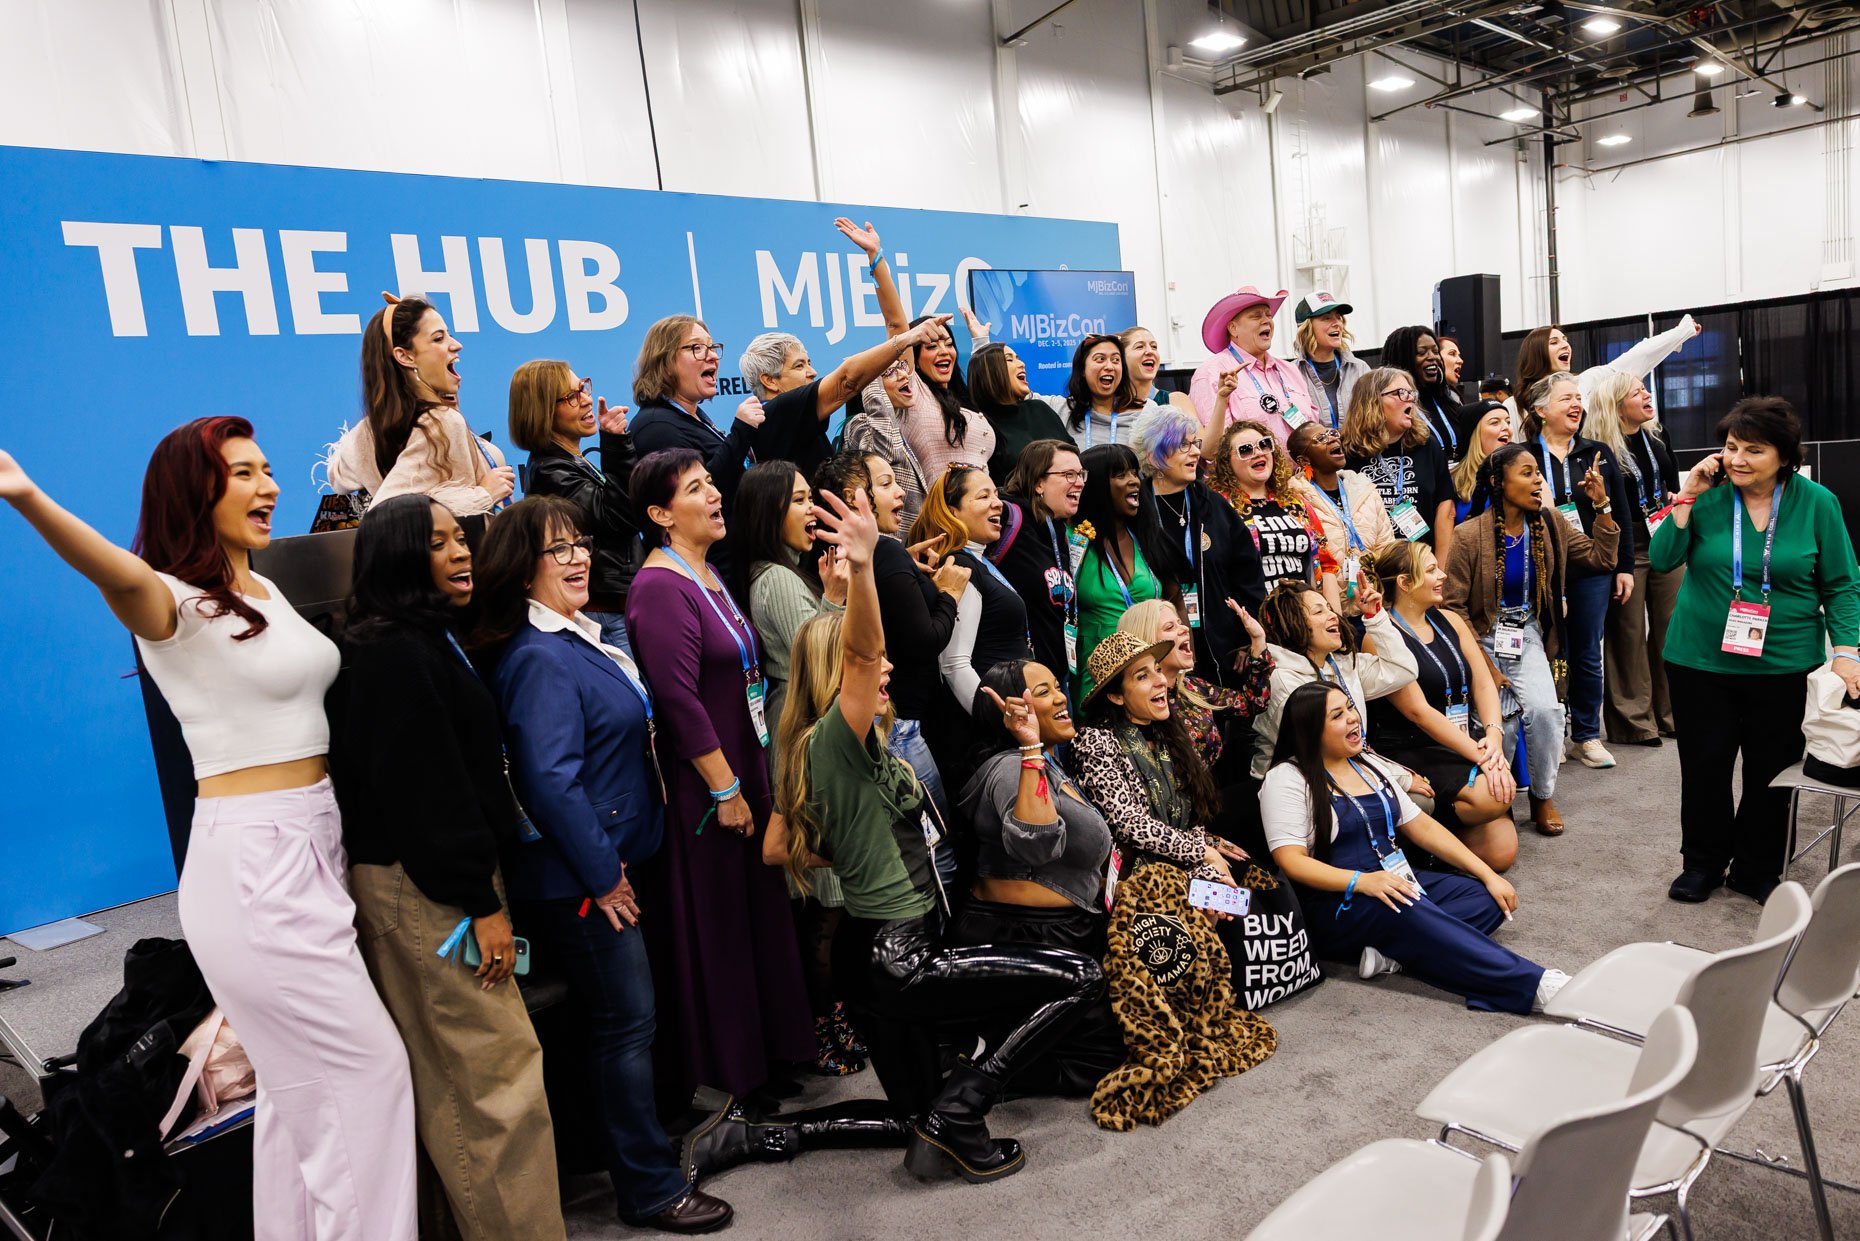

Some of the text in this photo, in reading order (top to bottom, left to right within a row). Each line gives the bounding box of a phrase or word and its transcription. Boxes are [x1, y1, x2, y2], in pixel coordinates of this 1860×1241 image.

[61, 220, 361, 337] THE
[390, 233, 629, 334] HUB
[1087, 280, 1129, 294] MJBizCon
[1011, 313, 1105, 343] MJBizCon
[1253, 515, 1303, 531] End
[1261, 532, 1309, 553] The
[1262, 554, 1303, 577] Drug
[1133, 916, 1157, 935] HIGH
[1244, 911, 1294, 937] BUY
[1133, 926, 1172, 953] SOCIETY
[1244, 928, 1310, 962] WEED
[1156, 952, 1192, 985] MAMAS
[1245, 951, 1311, 987] FROM
